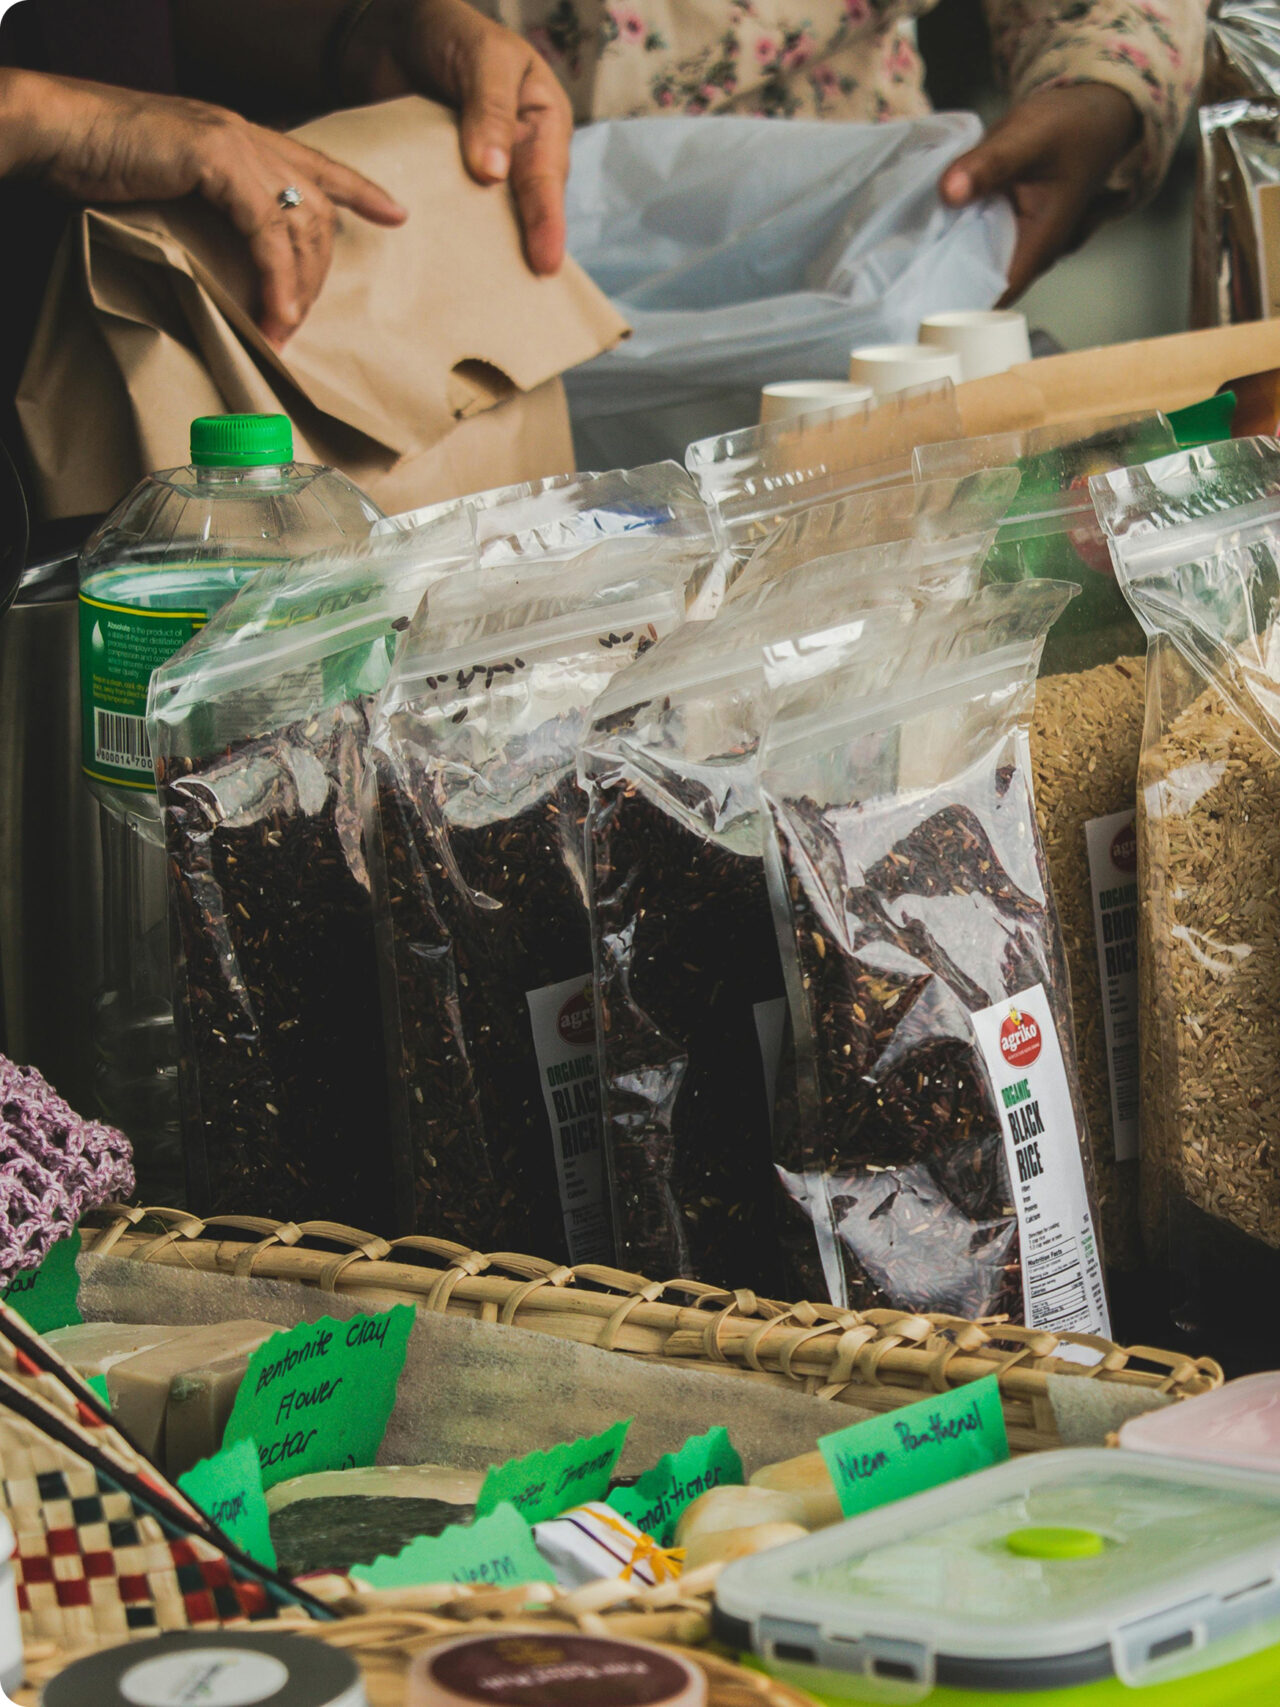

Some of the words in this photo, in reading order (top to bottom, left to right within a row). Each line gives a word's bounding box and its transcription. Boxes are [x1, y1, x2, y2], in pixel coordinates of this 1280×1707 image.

[146, 628, 175, 639] product
[101, 750, 131, 766] 800014
[135, 757, 153, 769] 700
[1112, 836, 1138, 860] agr
[1099, 883, 1138, 911] ORGANI
[1102, 903, 1138, 944] BRO
[560, 1001, 596, 1028] agri
[1001, 1023, 1037, 1052] agriko
[547, 1054, 594, 1088] ORGANIC
[552, 1077, 601, 1124] BLAC
[1001, 1077, 1031, 1109] ORGANIC
[560, 1115, 598, 1160] RICE
[1008, 1100, 1046, 1146] BLACK
[1016, 1141, 1044, 1183] RICE
[1027, 1253, 1050, 1267] Nutrition
[1050, 1248, 1063, 1259] Facts
[275, 1377, 343, 1425] Flower
[258, 1429, 318, 1469] ectar
[835, 1451, 891, 1487] Neem
[893, 1400, 984, 1452] Panthenol
